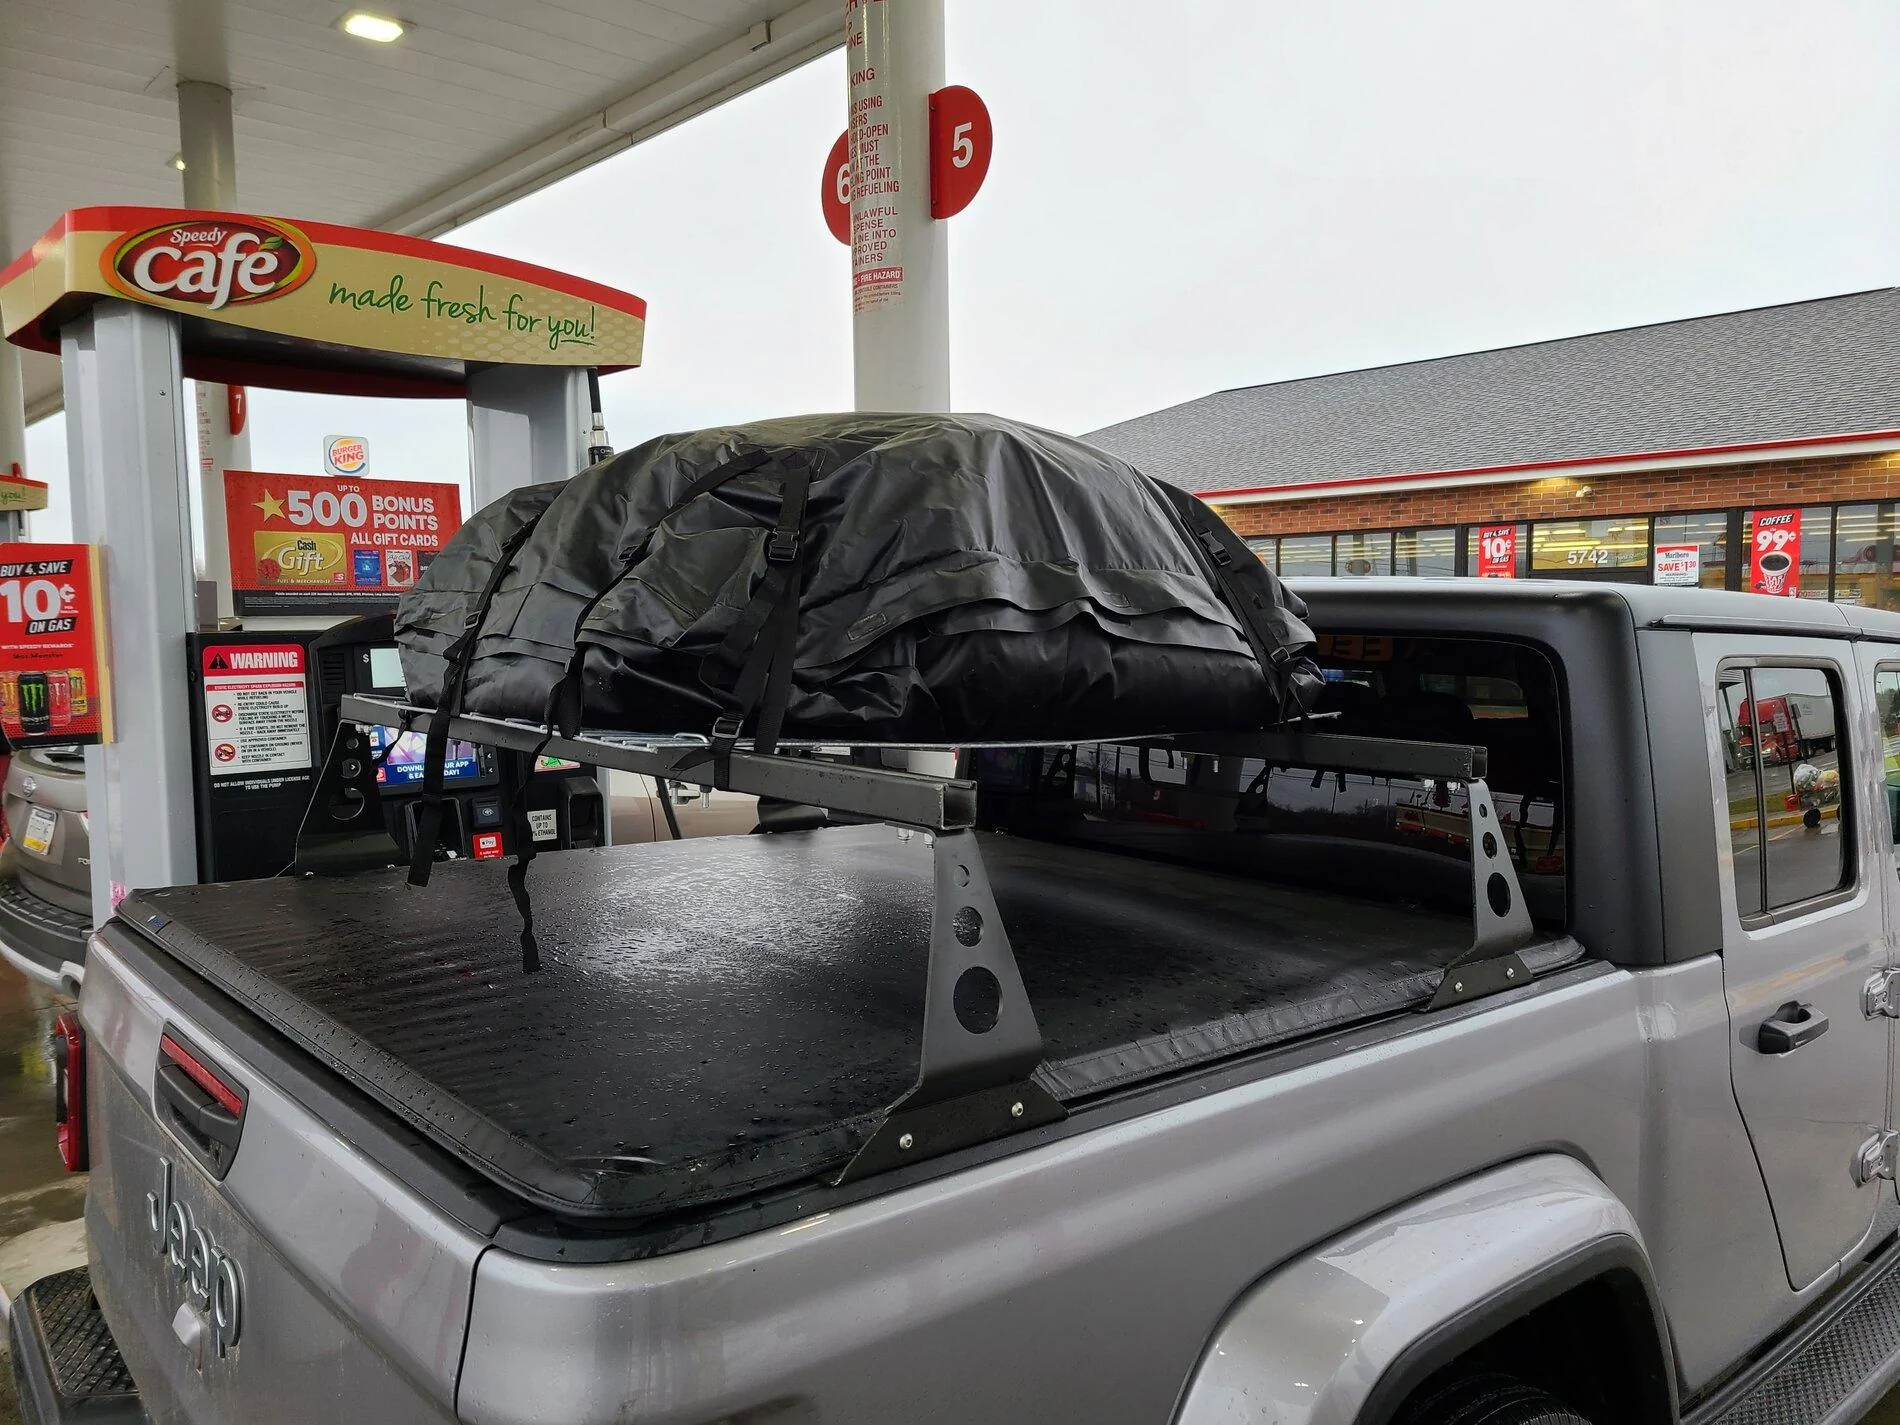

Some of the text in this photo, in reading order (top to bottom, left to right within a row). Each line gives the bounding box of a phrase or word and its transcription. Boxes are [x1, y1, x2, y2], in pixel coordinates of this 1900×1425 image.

[859, 96, 882, 112] USING
[952, 122, 973, 168] 5
[864, 154, 880, 167] THE
[866, 167, 891, 181] POINT
[837, 163, 850, 204] 6
[857, 180, 900, 199] REFUELING
[170, 227, 228, 245] Speedy
[872, 228, 896, 240] INTO
[873, 270, 900, 280] HAZARD
[328, 275, 596, 350] made fresh for you!
[332, 444, 363, 458] BURGER
[334, 452, 364, 465] KING
[349, 485, 359, 493] TO
[288, 490, 367, 527] 500
[372, 495, 435, 513] BONUS
[373, 513, 438, 531] POINTS
[1760, 515, 1792, 526] COFFEE
[297, 540, 317, 550] Cash
[351, 532, 438, 547] ALL GIFT CARDS
[1756, 530, 1796, 551] 99¢
[278, 547, 324, 576] Gift
[1567, 550, 1608, 565] 5742
[0, 561, 68, 577] BUY SAVE
[1658, 563, 1680, 571] SAVE
[0, 580, 76, 623] 10¢
[29, 619, 72, 633] ON GAS
[230, 652, 298, 669] WARNING
[363, 653, 369, 664] $
[532, 814, 552, 822] CONTAINS
[146, 1156, 243, 1358] Jeep
